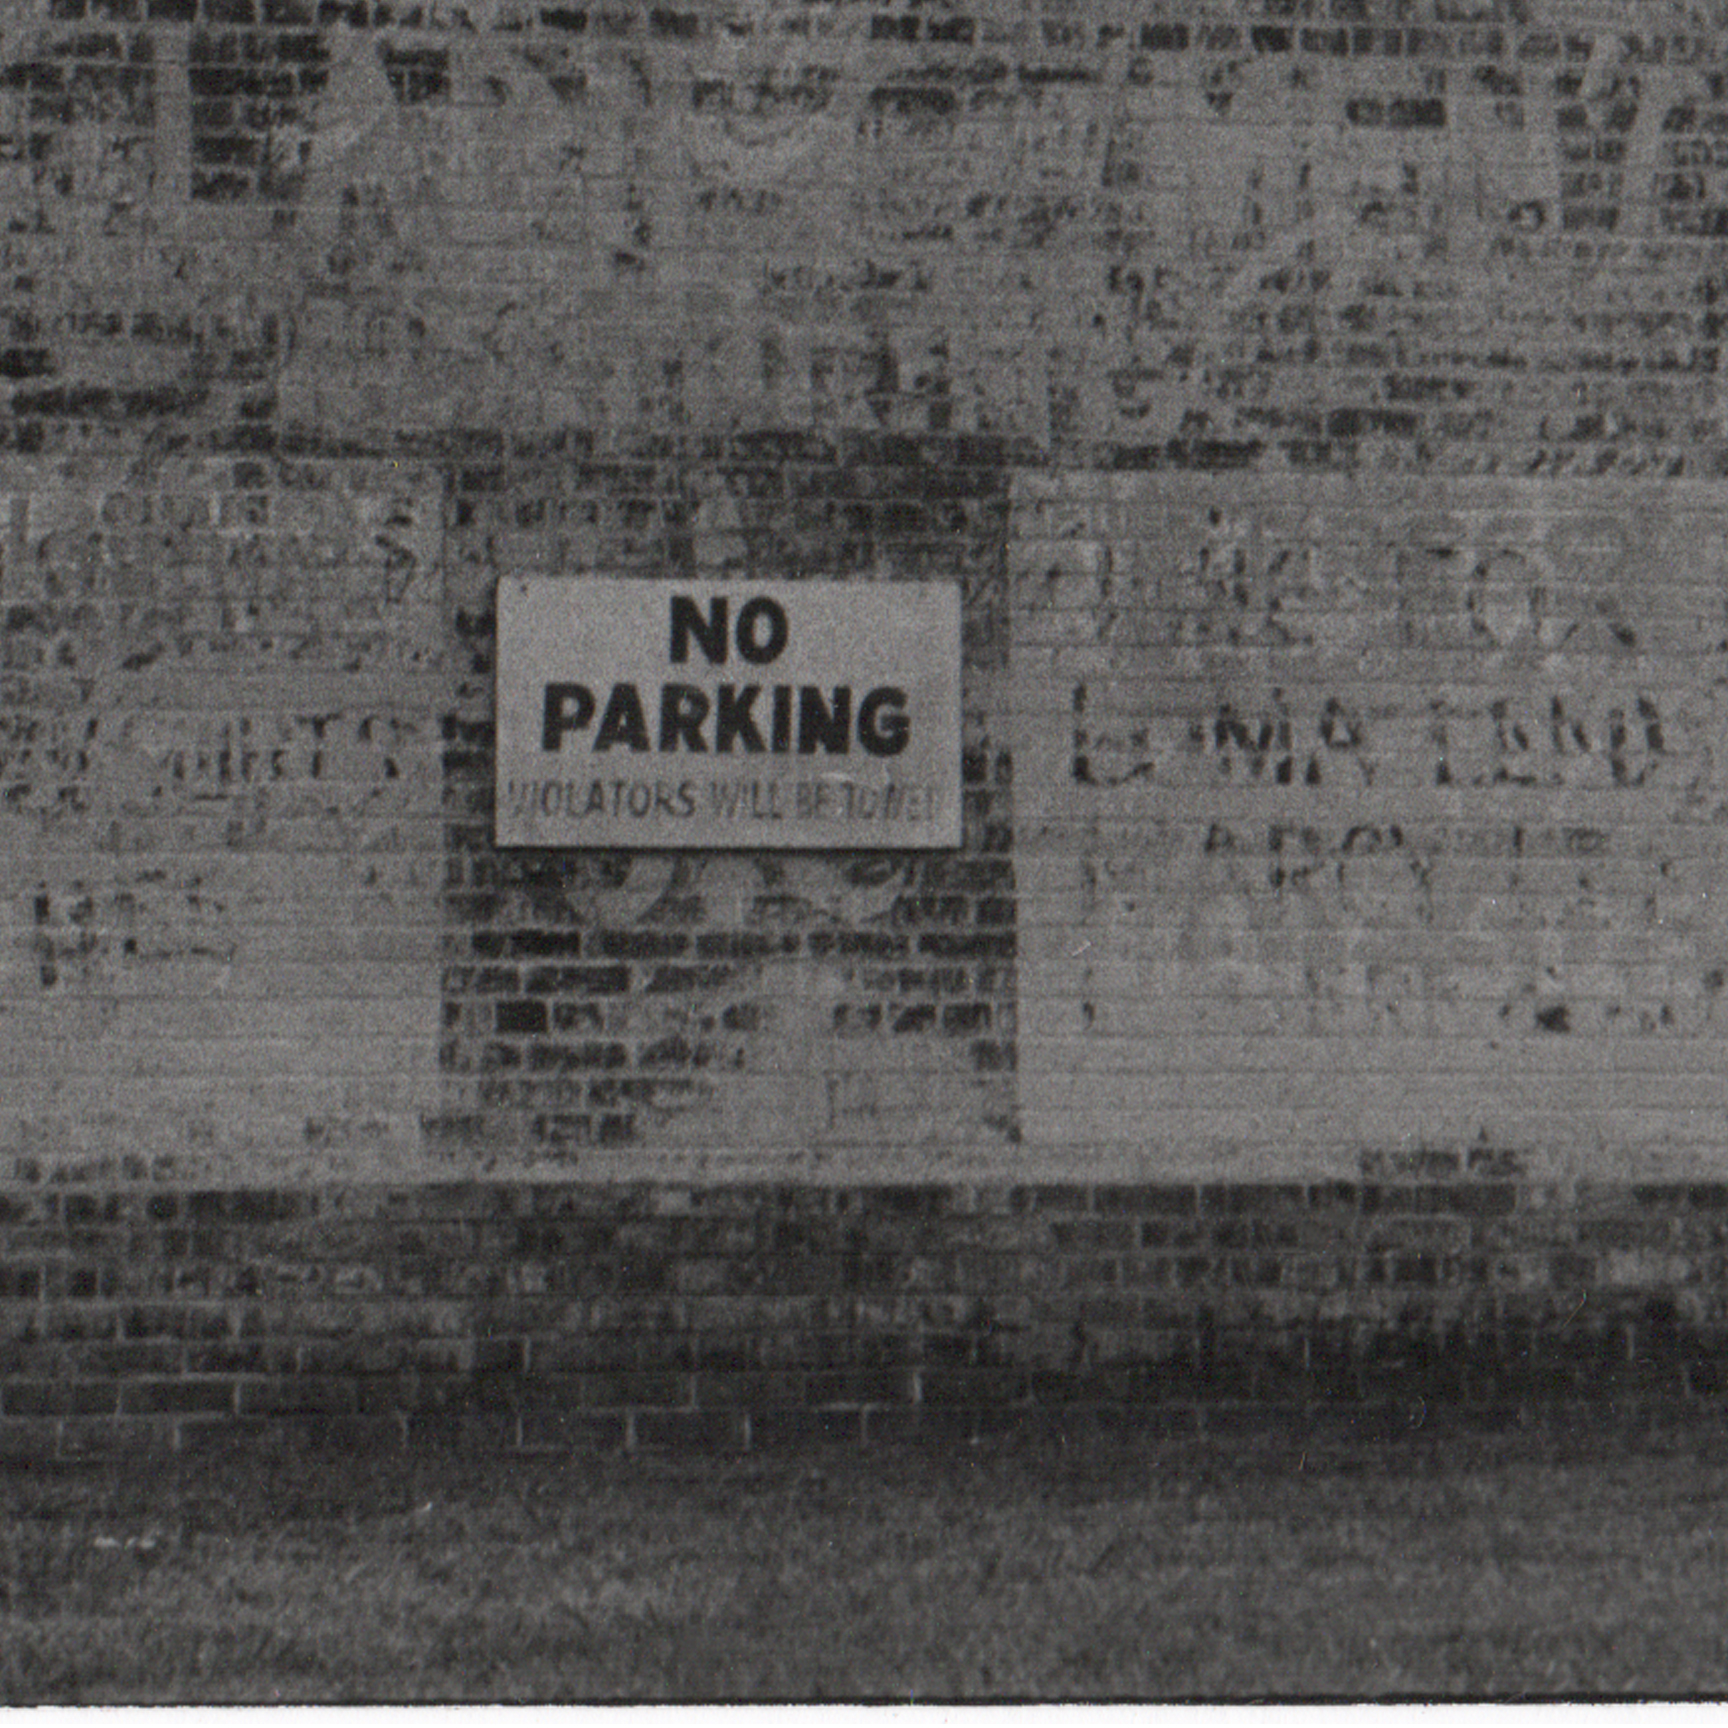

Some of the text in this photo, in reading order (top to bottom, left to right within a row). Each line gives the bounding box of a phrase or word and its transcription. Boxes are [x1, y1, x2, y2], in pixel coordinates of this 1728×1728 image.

[670, 595, 790, 665] NO
[540, 682, 912, 757] PARKING
[507, 779, 696, 819] VIOLATORS
[709, 780, 784, 820] WILL
